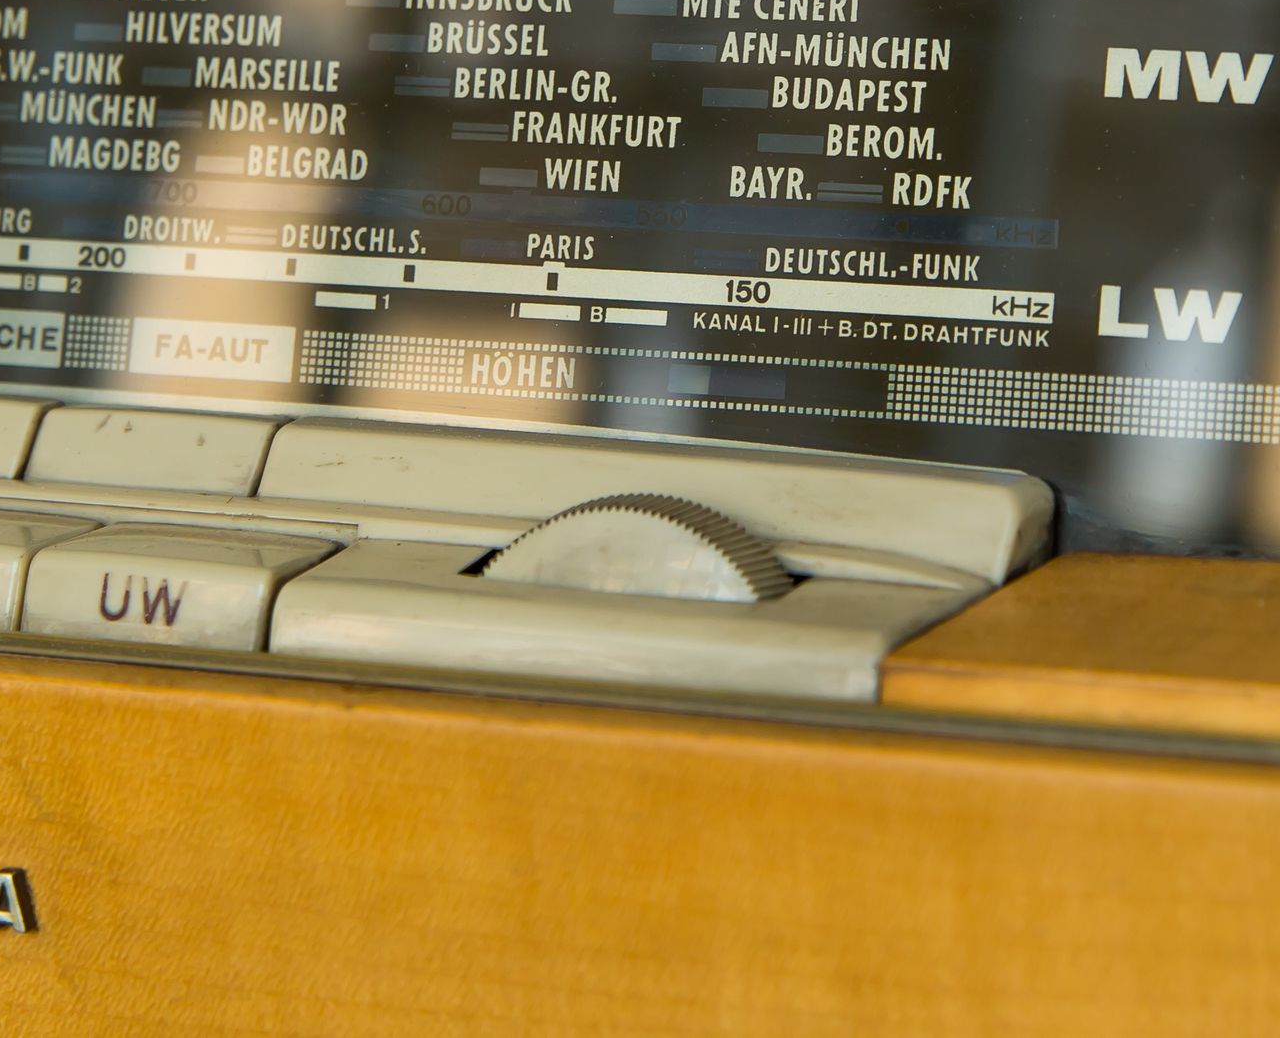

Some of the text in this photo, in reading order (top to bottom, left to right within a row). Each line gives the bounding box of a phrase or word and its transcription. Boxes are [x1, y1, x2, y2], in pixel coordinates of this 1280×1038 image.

[126, 11, 282, 47] HILVERSUM
[427, 23, 549, 58] BRÜSSEL
[720, 31, 951, 72] AFN-MÜNCHEN
[194, 56, 341, 93] MARSEILLE
[453, 68, 618, 105] BERLIN-GR.
[1105, 47, 1272, 106] MW
[20, 90, 157, 130] MÜNCHEN
[771, 76, 928, 115] BUDAPEST
[208, 99, 348, 136] NDR-WDR
[512, 110, 682, 149] FRANKFURT
[48, 134, 181, 173] MAGDEBG
[826, 124, 943, 161] BEROM.
[247, 145, 368, 182] BELGRAD
[545, 159, 621, 193] WIEN
[422, 194, 471, 216] 600
[729, 166, 972, 210] BAYR. RDFK
[123, 214, 221, 245] DROITW.
[526, 233, 595, 262] PARIS
[765, 247, 980, 281] DEUTSCHL.-FUNK
[24, 273, 36, 291] B
[70, 276, 83, 294] 2
[78, 247, 127, 270] 200
[726, 280, 771, 304] 150
[993, 295, 1052, 319] kHz
[381, 294, 390, 309] 1
[590, 306, 604, 323] B
[694, 311, 765, 333] KANAL
[773, 317, 812, 336] I-III
[904, 324, 1050, 349] DRAHTFUNK
[1098, 285, 1242, 343] LW
[155, 333, 270, 364] FA-AUT
[471, 351, 575, 389] HÖHEN
[98, 571, 188, 628] UW
